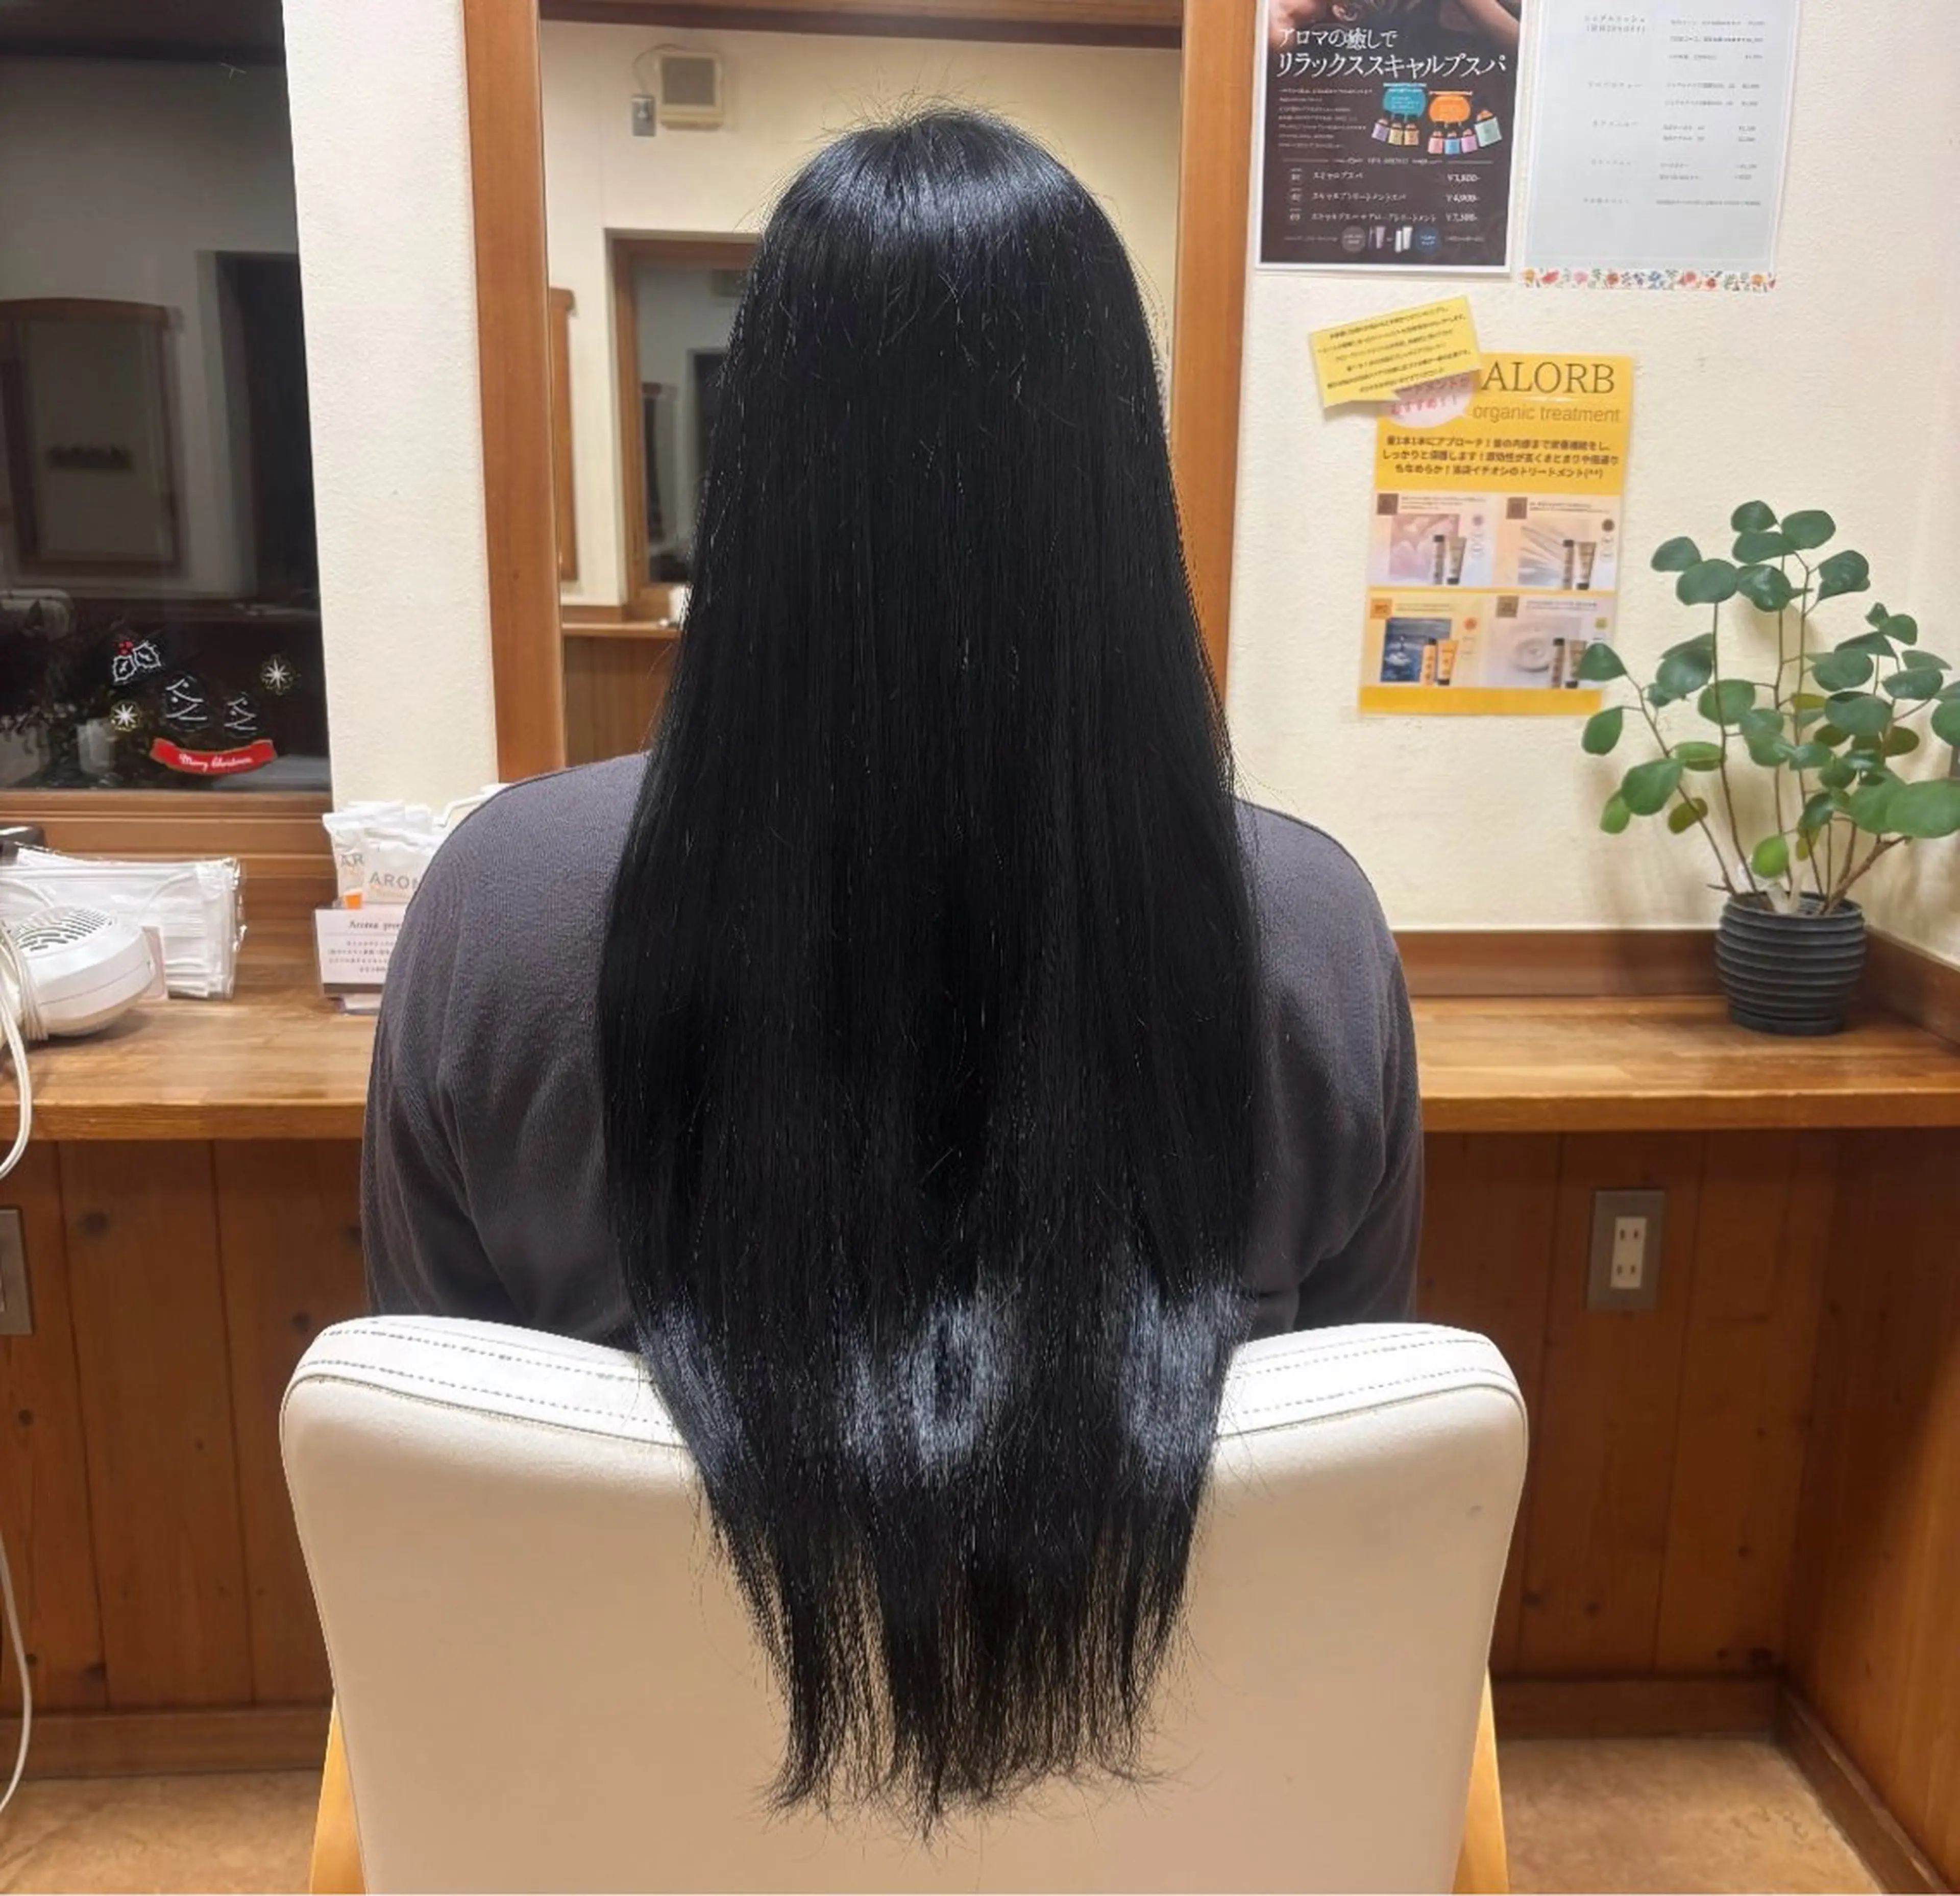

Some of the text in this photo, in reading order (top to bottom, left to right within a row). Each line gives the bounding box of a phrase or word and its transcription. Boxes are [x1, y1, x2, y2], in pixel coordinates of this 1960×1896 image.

[1280, 27, 1399, 50] アロマの癒しで
[1276, 52, 1507, 80] リラックススキャルプスパ
[1481, 360, 1615, 394] ALORB
[1473, 405, 1620, 424] organic treatment
